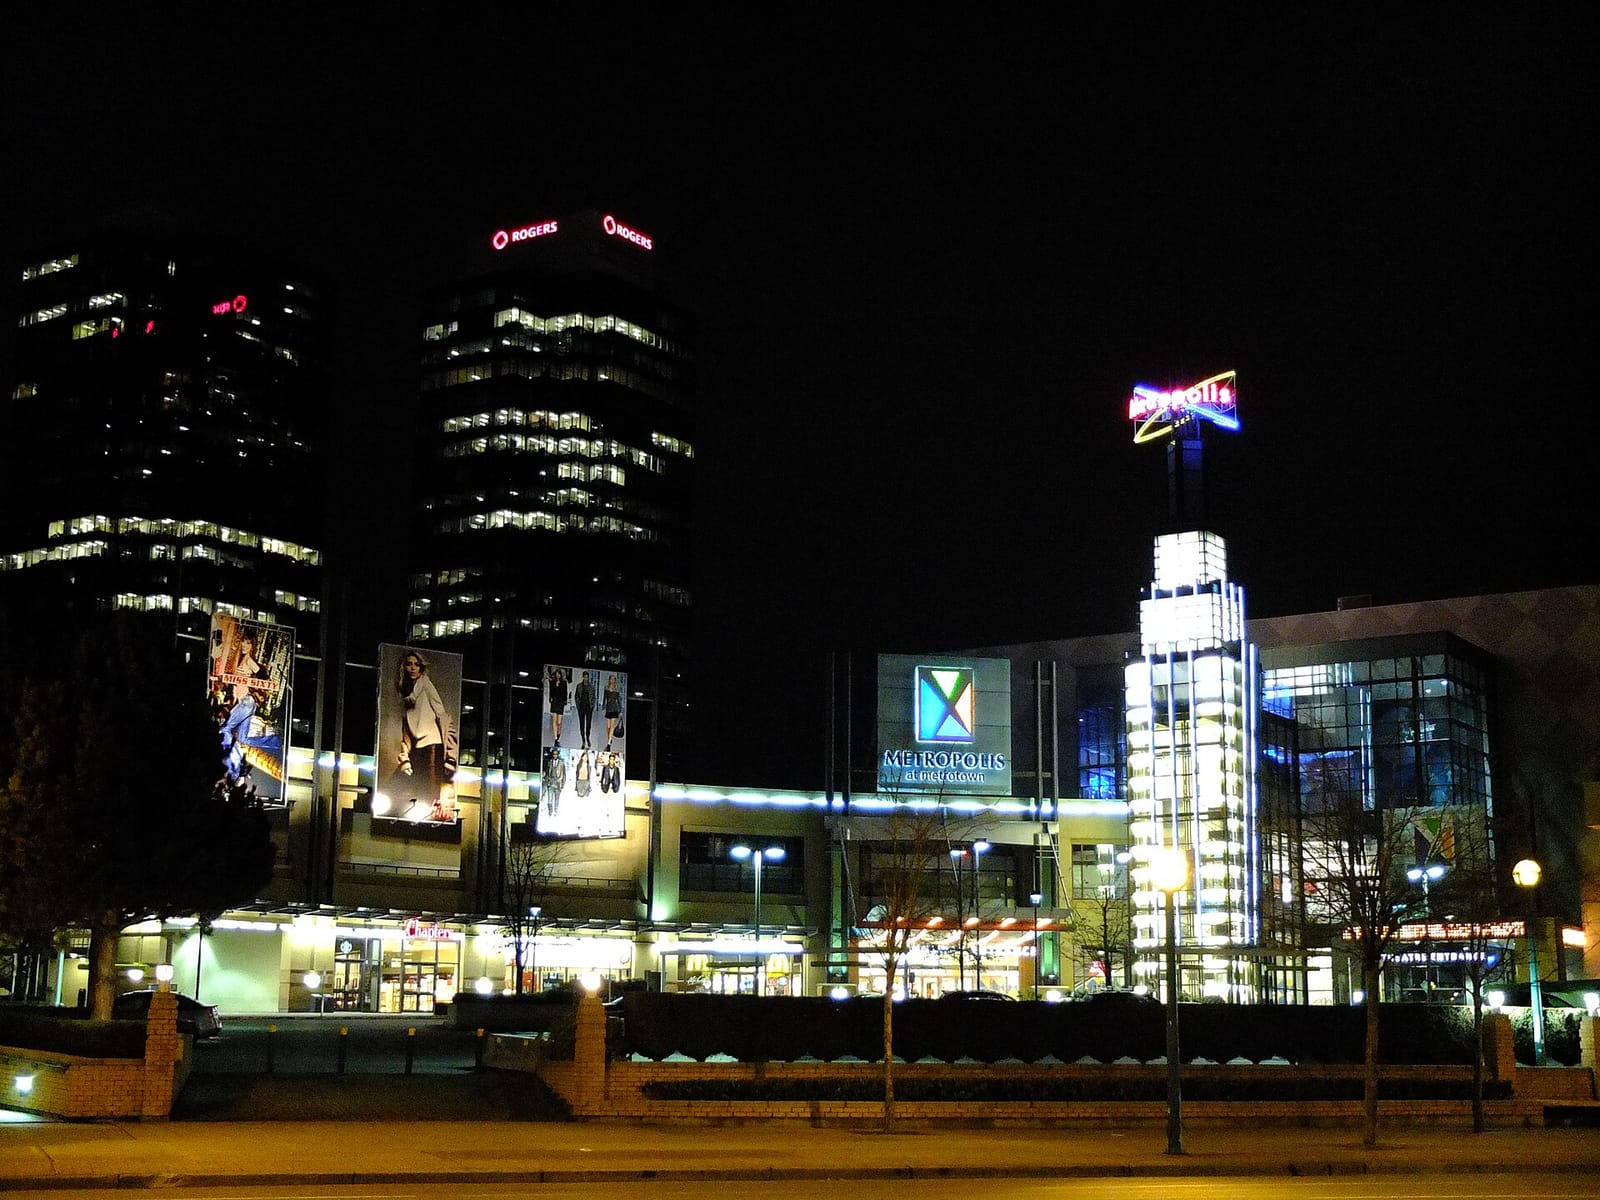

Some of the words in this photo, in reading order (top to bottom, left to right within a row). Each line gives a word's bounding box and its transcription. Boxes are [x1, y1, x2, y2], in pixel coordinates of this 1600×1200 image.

[512, 221, 558, 242] ROGERS
[616, 224, 653, 250] ROGERS
[1129, 384, 1231, 420] opolis
[223, 674, 248, 685] MISS
[250, 679, 279, 691] SIXTY
[883, 749, 1007, 770] METROPOLIS
[904, 770, 919, 781] at
[920, 771, 985, 783] metrotown
